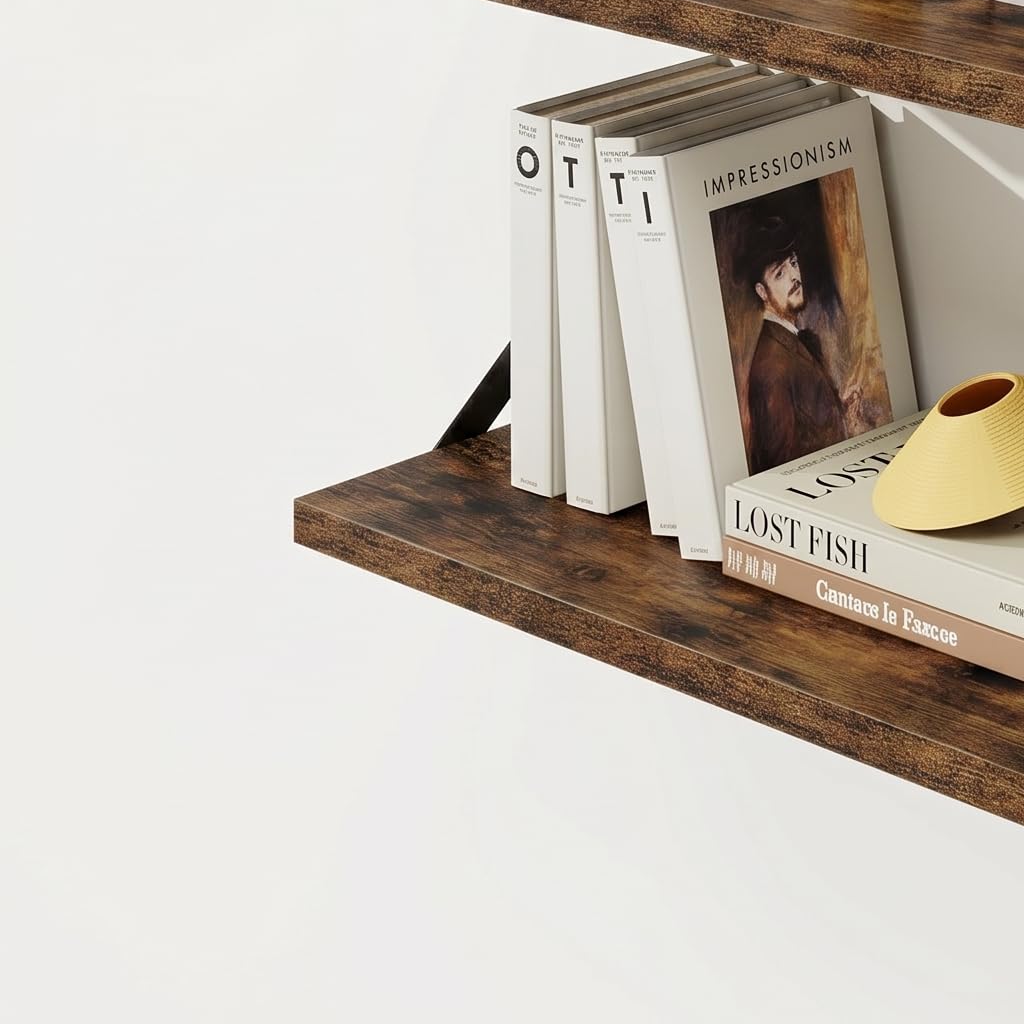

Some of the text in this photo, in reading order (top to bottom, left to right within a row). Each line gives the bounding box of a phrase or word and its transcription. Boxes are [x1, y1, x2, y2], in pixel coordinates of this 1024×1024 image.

[516, 145, 540, 179] O
[562, 155, 579, 189] T
[703, 136, 853, 199] IMPRESSIONISM
[609, 172, 625, 205] T
[642, 191, 653, 225] I
[785, 451, 897, 500] LOST
[734, 499, 803, 549] LOST
[808, 524, 869, 574] FISH
